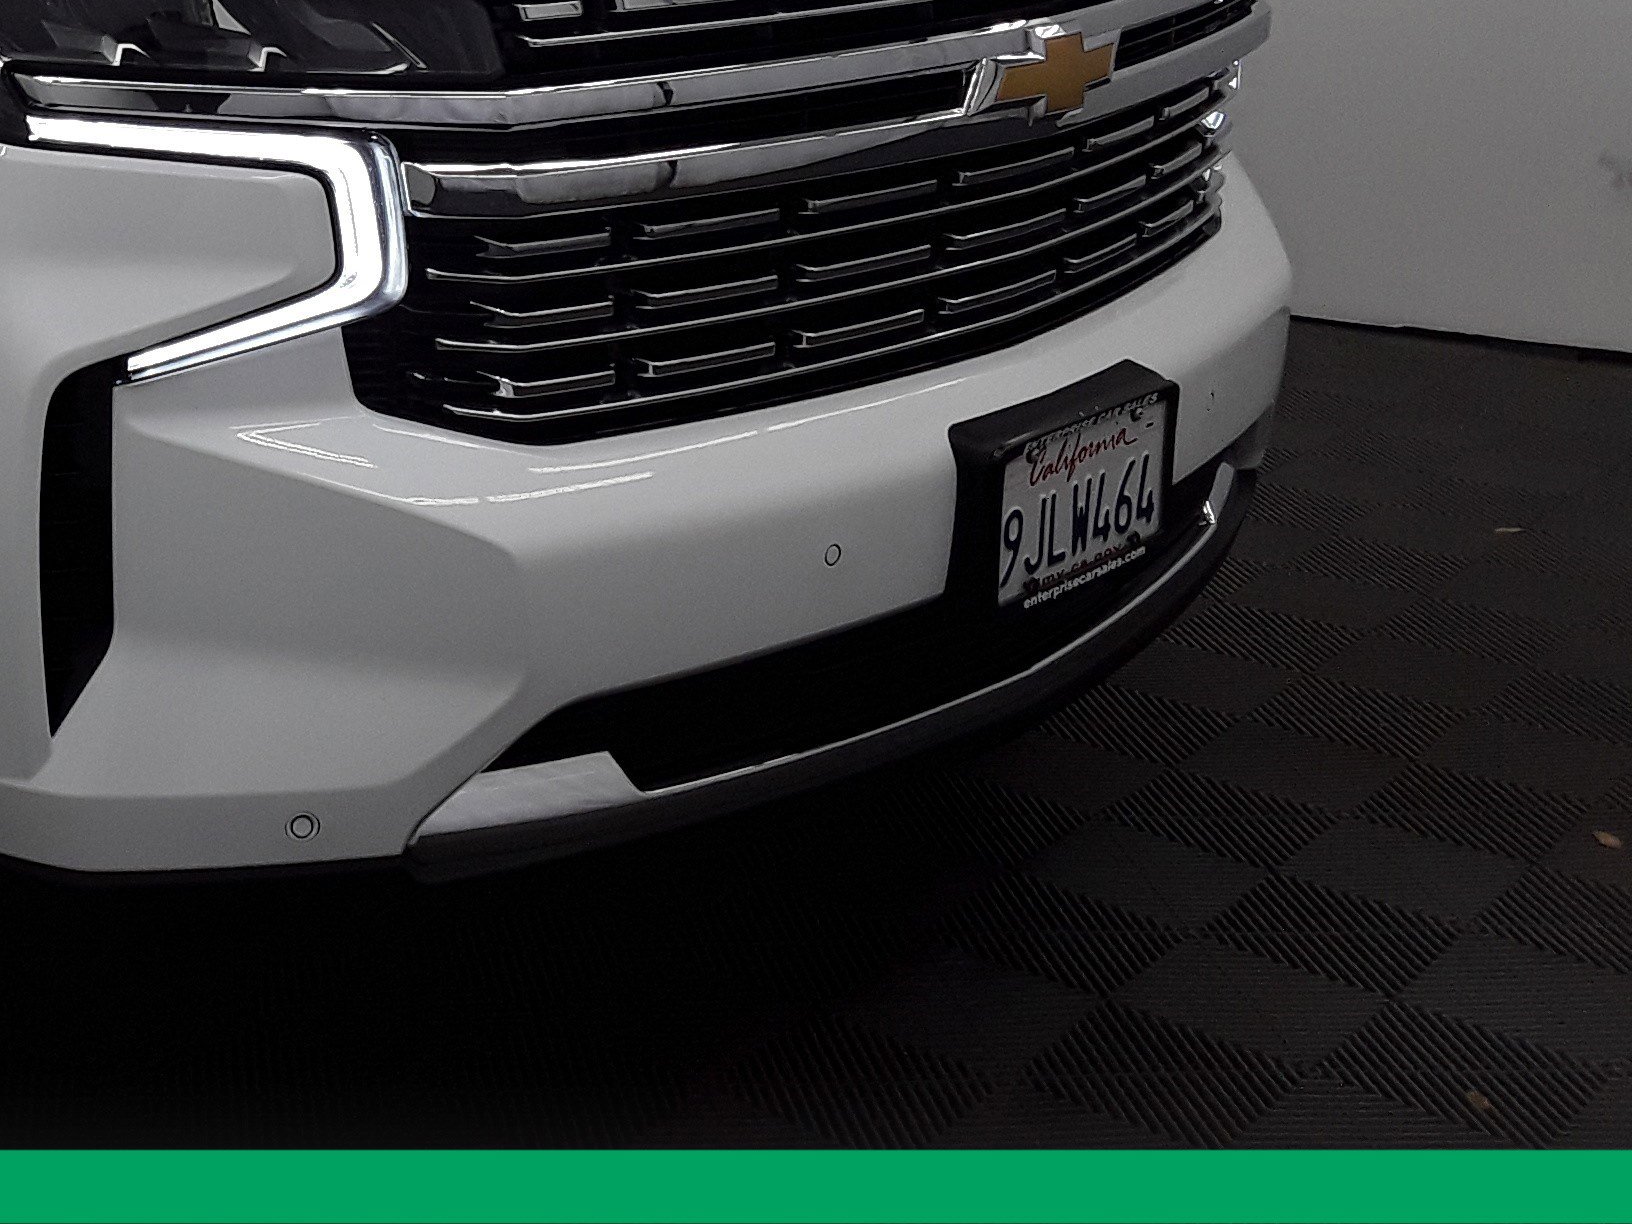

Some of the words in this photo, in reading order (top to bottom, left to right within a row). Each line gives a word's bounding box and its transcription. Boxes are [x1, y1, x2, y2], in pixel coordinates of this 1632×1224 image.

[1029, 428, 1138, 487] California
[999, 452, 1155, 589] 9JLW464
[1023, 545, 1146, 609] enterprisecarsales.com
